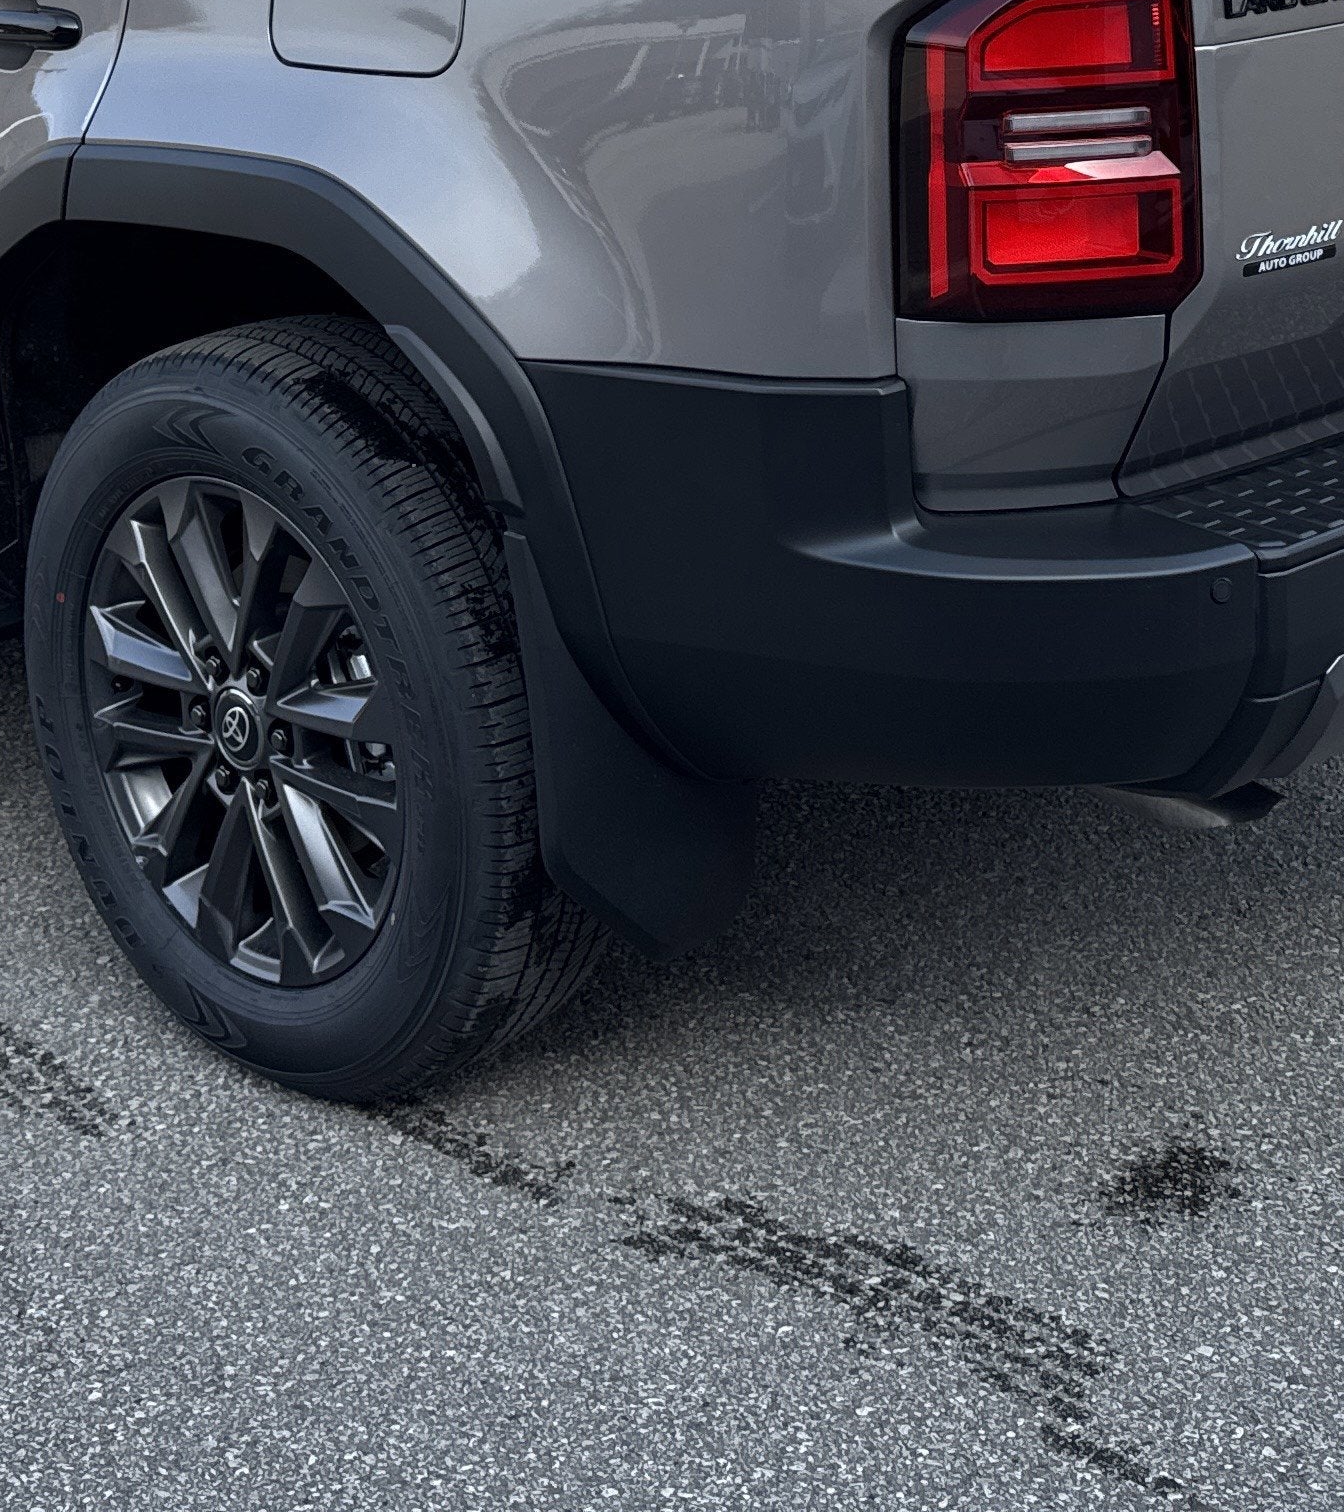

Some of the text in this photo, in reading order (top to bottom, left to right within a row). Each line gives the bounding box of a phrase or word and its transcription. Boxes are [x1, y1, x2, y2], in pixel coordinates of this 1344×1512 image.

[1235, 219, 1344, 261] Thornhill
[1258, 248, 1324, 273] AUTO GROUP
[34, 694, 145, 951] DUNLOP
